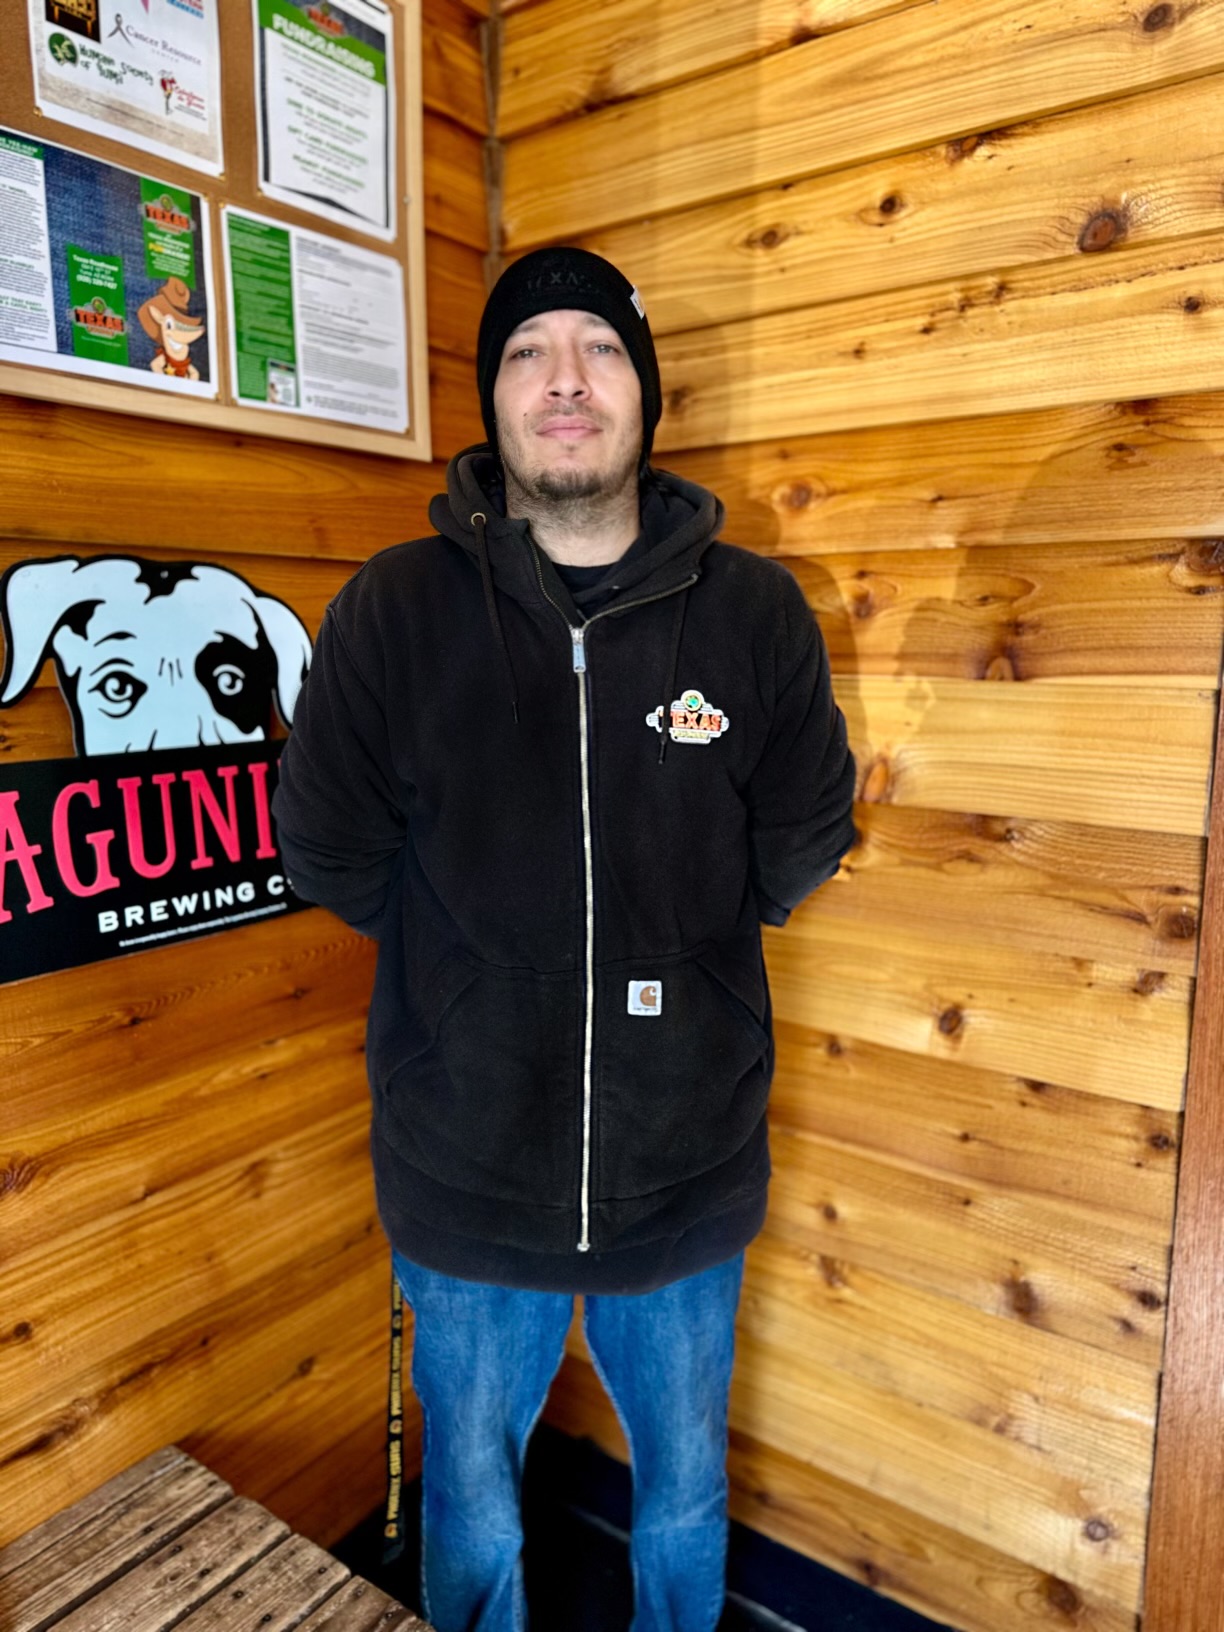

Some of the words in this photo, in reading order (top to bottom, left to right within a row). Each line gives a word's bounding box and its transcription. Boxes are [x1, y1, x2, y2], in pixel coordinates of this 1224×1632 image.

[659, 709, 722, 732] EXAS
[0, 758, 281, 924] AGUNI
[98, 882, 255, 933] BREWING
